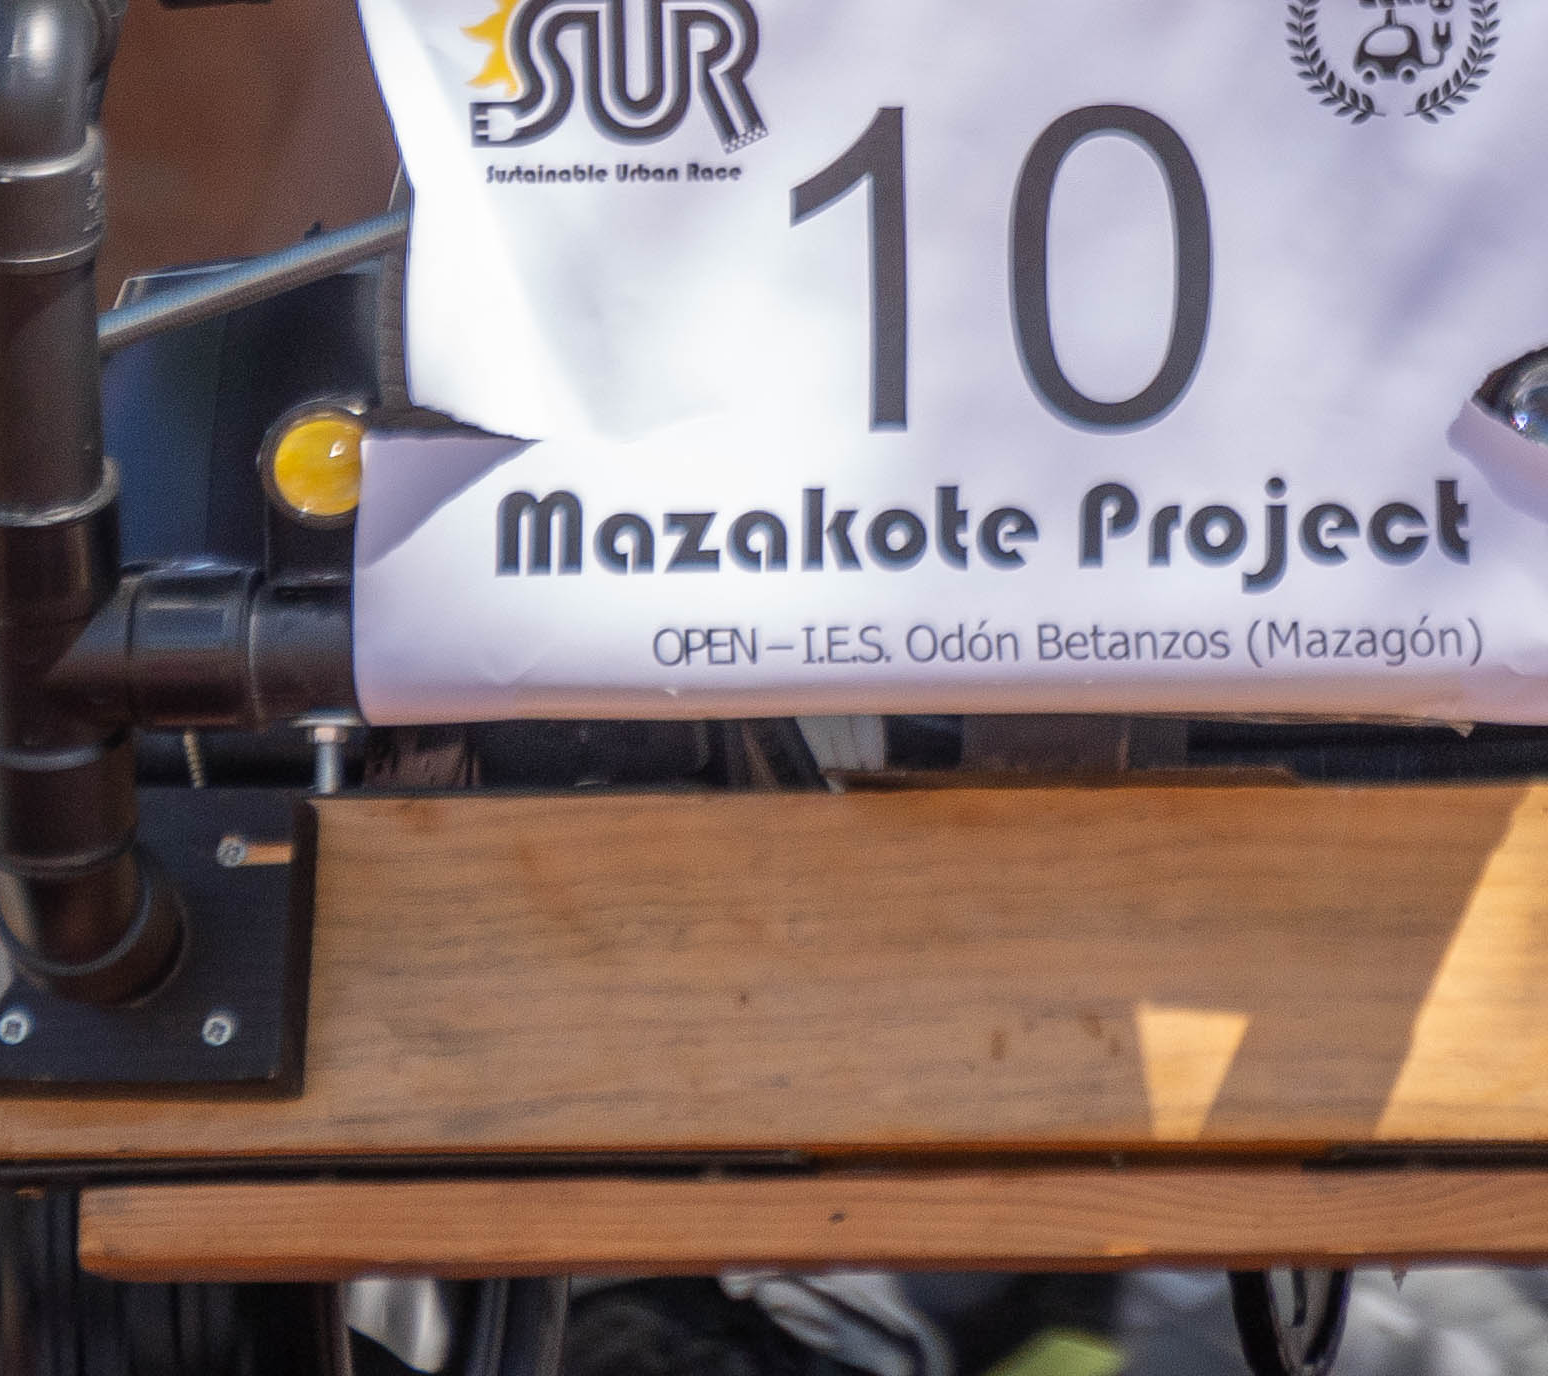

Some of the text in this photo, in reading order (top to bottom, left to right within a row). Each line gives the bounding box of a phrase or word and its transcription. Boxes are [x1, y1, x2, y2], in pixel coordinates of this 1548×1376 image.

[486, 162, 742, 184] Sustainable Urban Race
[787, 102, 1215, 435] 10
[495, 476, 1473, 593] Mazakote Project
[652, 627, 759, 668] OPEN
[802, 623, 893, 665] I.E.S.
[905, 618, 1020, 664] Odón
[1037, 622, 1232, 663] Betanzos
[1246, 612, 1484, 668] (Mazagón)
